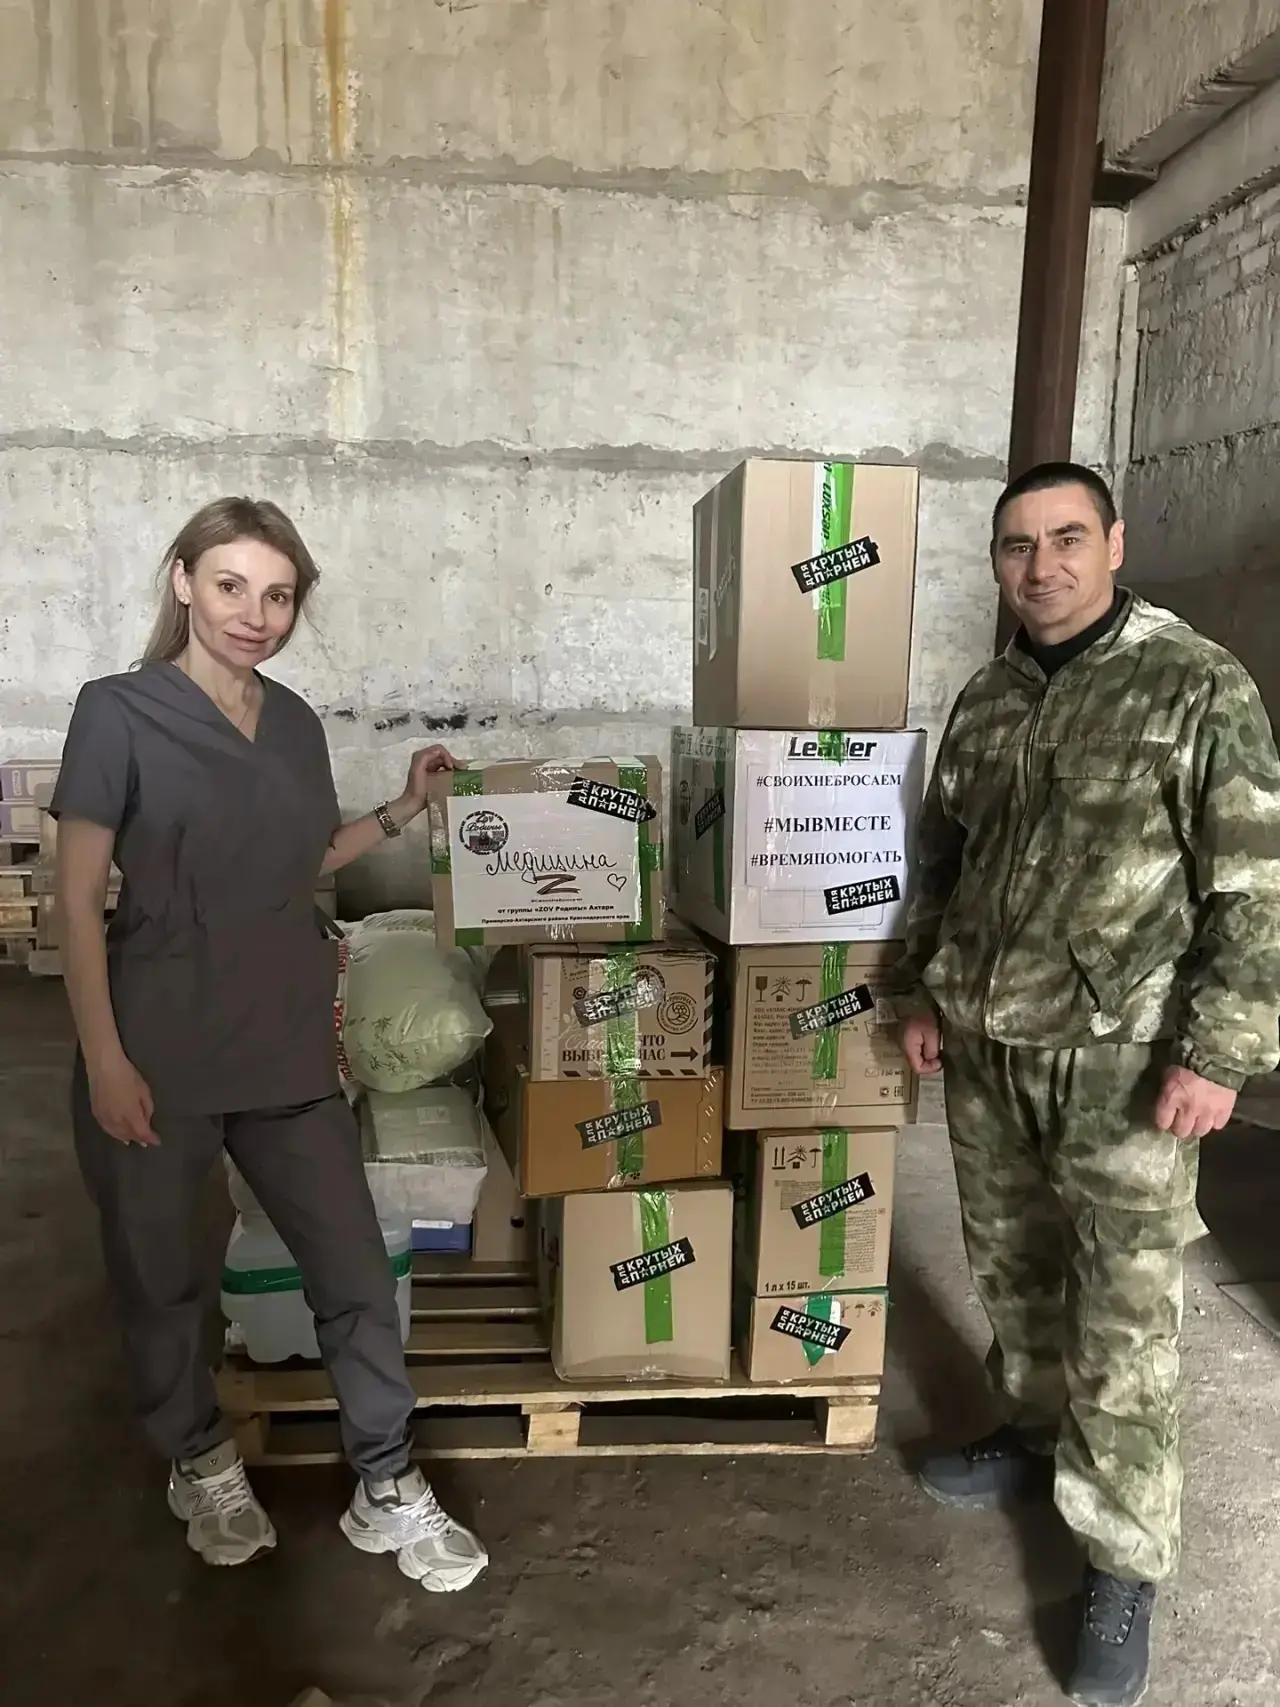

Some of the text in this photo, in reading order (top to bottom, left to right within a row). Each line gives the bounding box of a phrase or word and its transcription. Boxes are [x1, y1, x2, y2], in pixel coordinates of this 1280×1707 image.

[810, 541, 866, 572] КРУТЫХ
[800, 564, 815, 586] ДЛЯ
[787, 736, 877, 759] Leder
[756, 774, 902, 787] #СВОИХНЕБРОСАЕМ
[578, 781, 590, 804] ДЛЯ
[591, 784, 647, 809] КРУТЫХ
[764, 815, 892, 833] #МЫВМЕСТЕ
[485, 851, 618, 885] Медицина
[750, 850, 903, 867] #ВРЕМЯПОМОГАТЬ
[840, 878, 892, 898] КРУТЫХ
[830, 890, 840, 909] ДЛЯ
[507, 907, 533, 915] группы
[805, 991, 857, 1019] КРУТЫХ
[797, 1012, 808, 1032] ДЛЯ
[595, 1105, 649, 1129] КРУТЫХ
[586, 1122, 596, 1142] ДЛЯ
[810, 1179, 861, 1209] КРУТЫХ
[801, 1203, 813, 1222] ДЛЯ
[626, 1243, 681, 1271] КРУТЫХ
[617, 1264, 630, 1284] ДЛЯ
[765, 1282, 769, 1292] 1
[787, 1280, 796, 1290] 15
[797, 1281, 810, 1290] шт.
[777, 1309, 790, 1330] ДЛЯ
[790, 1313, 840, 1336] КРУТЫХ
